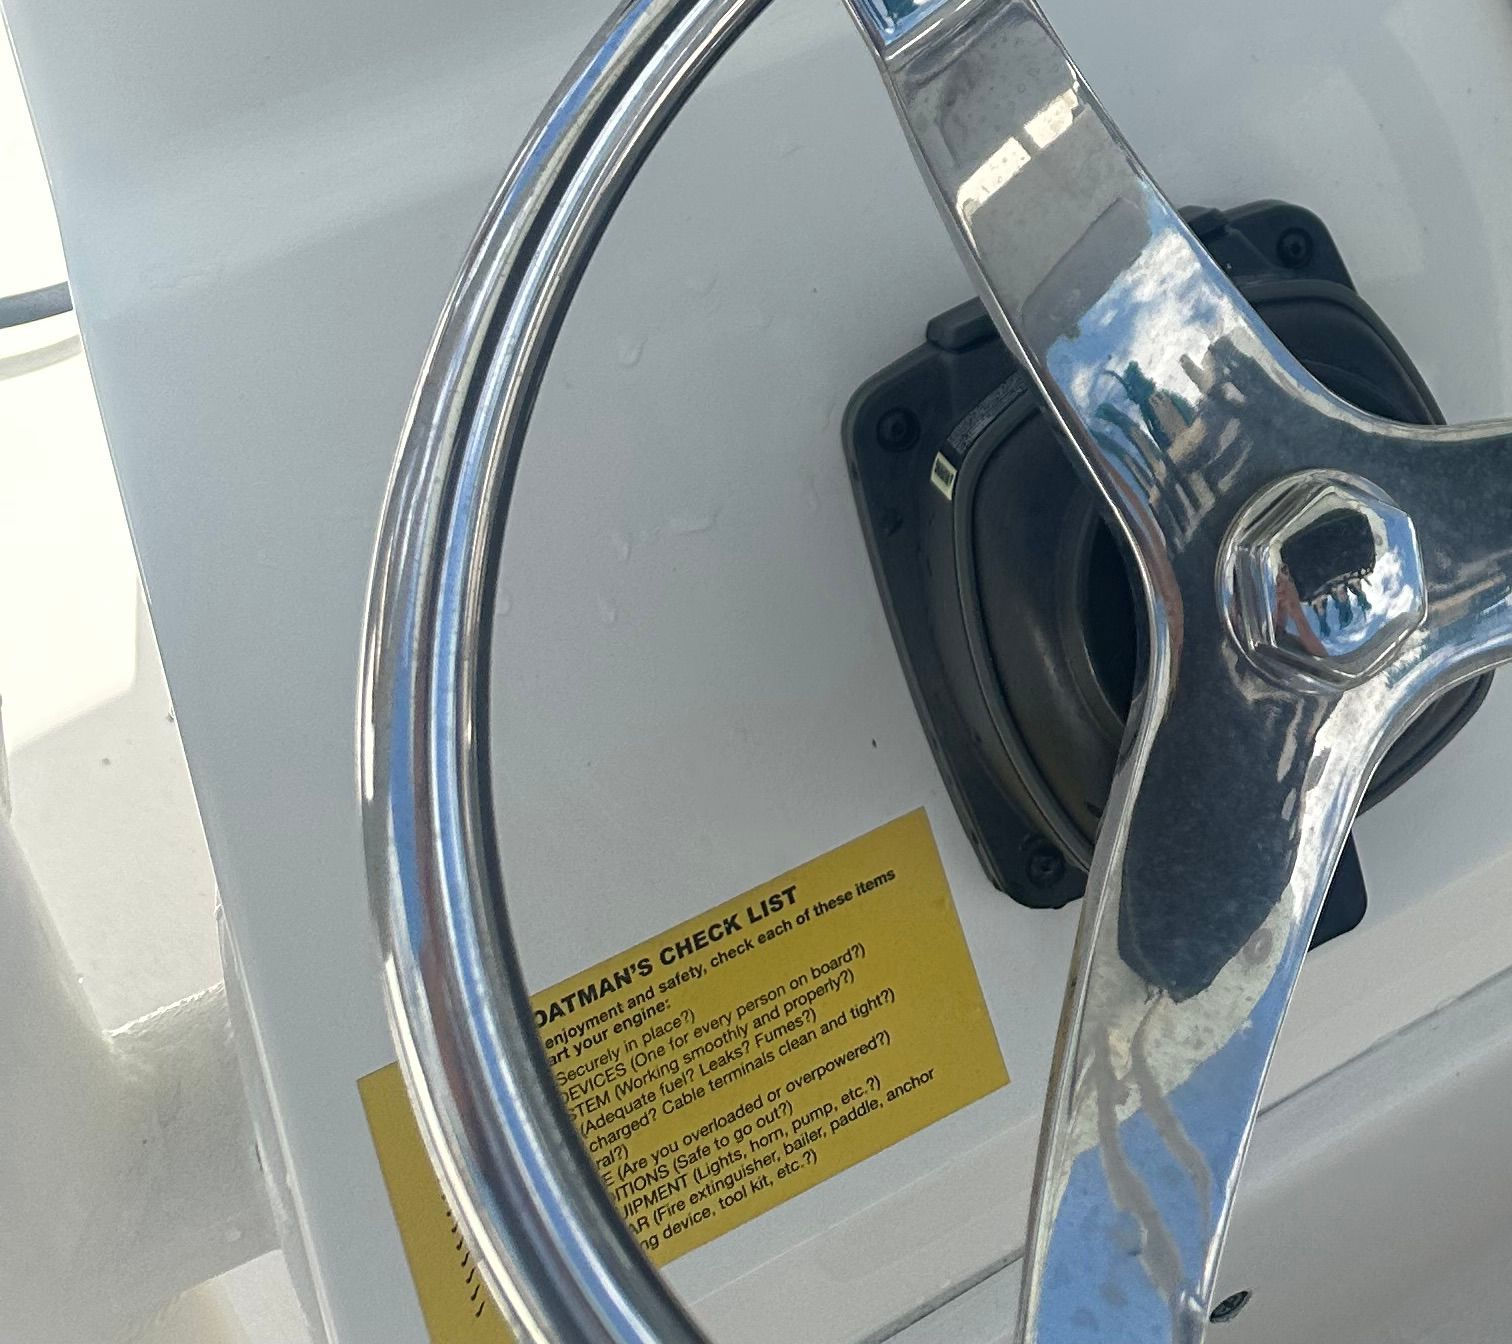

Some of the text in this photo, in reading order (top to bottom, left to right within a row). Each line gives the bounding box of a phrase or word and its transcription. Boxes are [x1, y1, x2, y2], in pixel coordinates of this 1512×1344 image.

[545, 869, 896, 1049] enjoyment and safety, check each of these items
[659, 912, 743, 966] CHECK
[746, 885, 797, 924] LIST
[556, 1008, 696, 1086] Securely in place?)
[573, 1028, 608, 1057] your
[613, 998, 672, 1035] engine:
[580, 1007, 817, 1139] (Adequate fuel? Leaks? Fumes?)
[589, 987, 896, 1153] charged? Cable terminals clean and tight?)
[614, 968, 855, 1101] (Working smoothly and properly?)
[630, 1045, 666, 1073] (One
[669, 1033, 689, 1051] for
[693, 1011, 732, 1038] every
[737, 984, 786, 1020] person
[789, 974, 808, 991] on
[810, 942, 866, 980] board?)
[613, 1100, 793, 1202] ITIONS (Safe to go out?)
[617, 1157, 648, 1182] (Are
[651, 1141, 679, 1166] you
[682, 1095, 764, 1146] overloaded
[767, 1086, 782, 1102] or
[785, 1030, 891, 1093] overpowered?)
[653, 1067, 935, 1226] (Fire extinguisher, bailer, paddle, anchor
[693, 1148, 748, 1185] (Lights,
[750, 1128, 789, 1153] horn,
[791, 1101, 839, 1134] pump,
[840, 1074, 882, 1106] etc.?)
[662, 1205, 716, 1240] device,
[718, 1184, 748, 1210] tool
[750, 1174, 774, 1196] kit,
[776, 1148, 818, 1179] etc.?)
